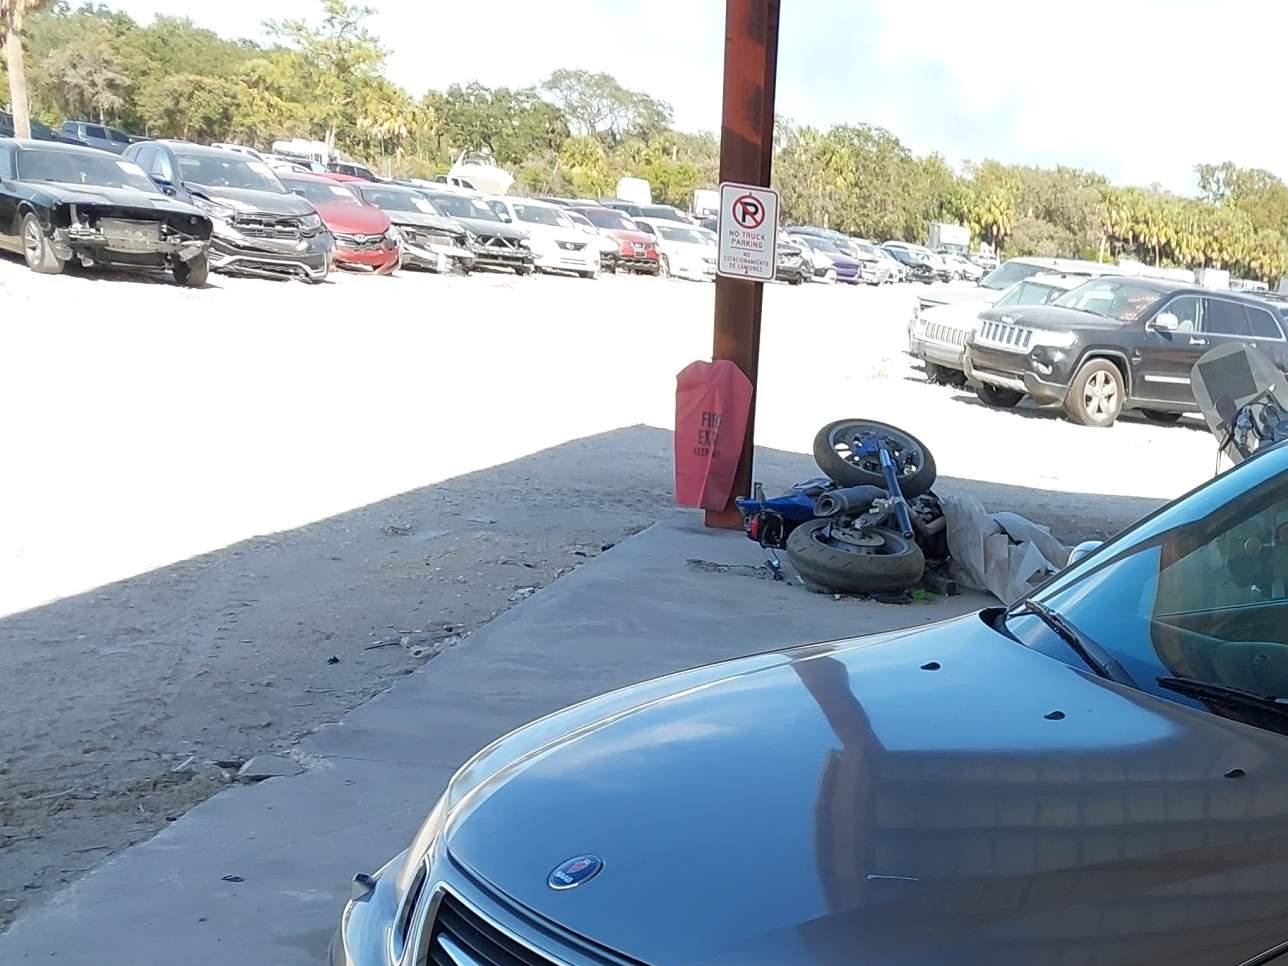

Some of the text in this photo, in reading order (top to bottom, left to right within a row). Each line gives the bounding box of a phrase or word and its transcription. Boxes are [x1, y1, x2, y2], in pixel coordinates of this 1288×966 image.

[729, 230, 766, 241] NO TRUCK
[731, 238, 763, 249] PARKING
